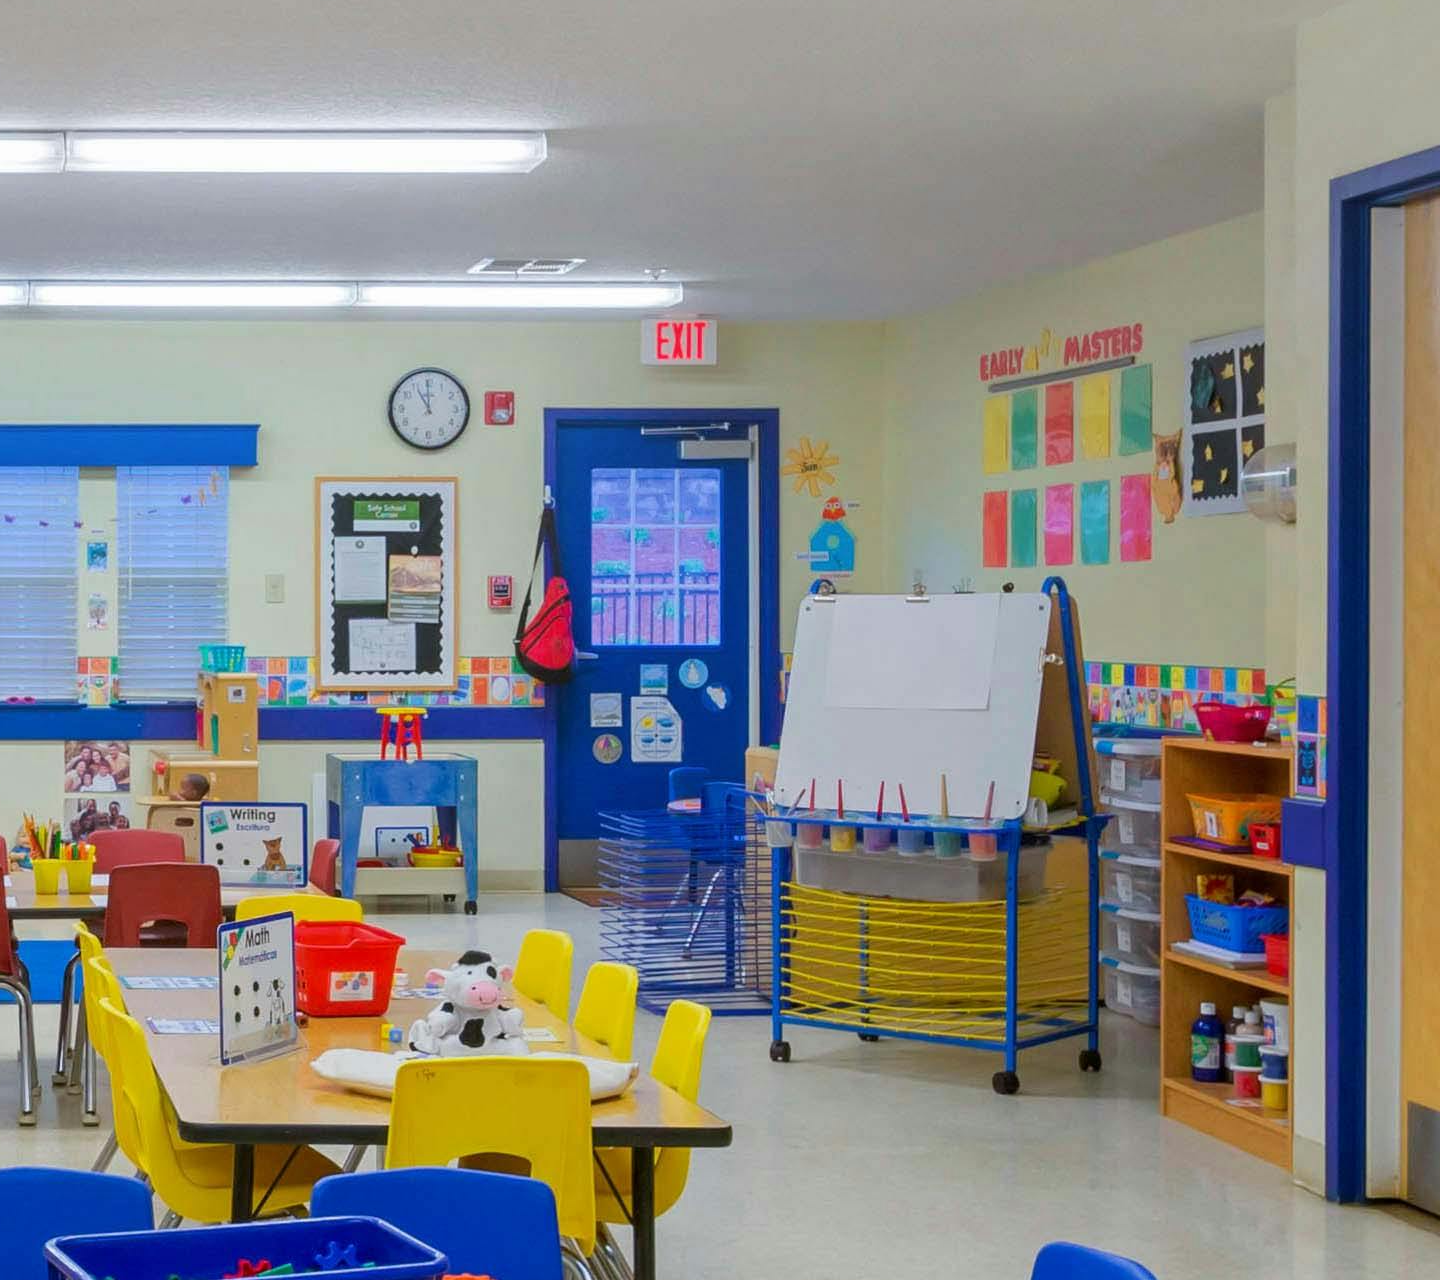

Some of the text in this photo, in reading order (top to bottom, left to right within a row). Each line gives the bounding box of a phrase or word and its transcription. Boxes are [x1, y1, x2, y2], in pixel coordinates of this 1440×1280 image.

[656, 322, 707, 360] EXIT
[979, 346, 1024, 381] EARLY
[1063, 323, 1143, 366] MASTERS
[230, 808, 276, 822] Writing
[236, 823, 270, 832] Escritura
[245, 926, 270, 948] Math
